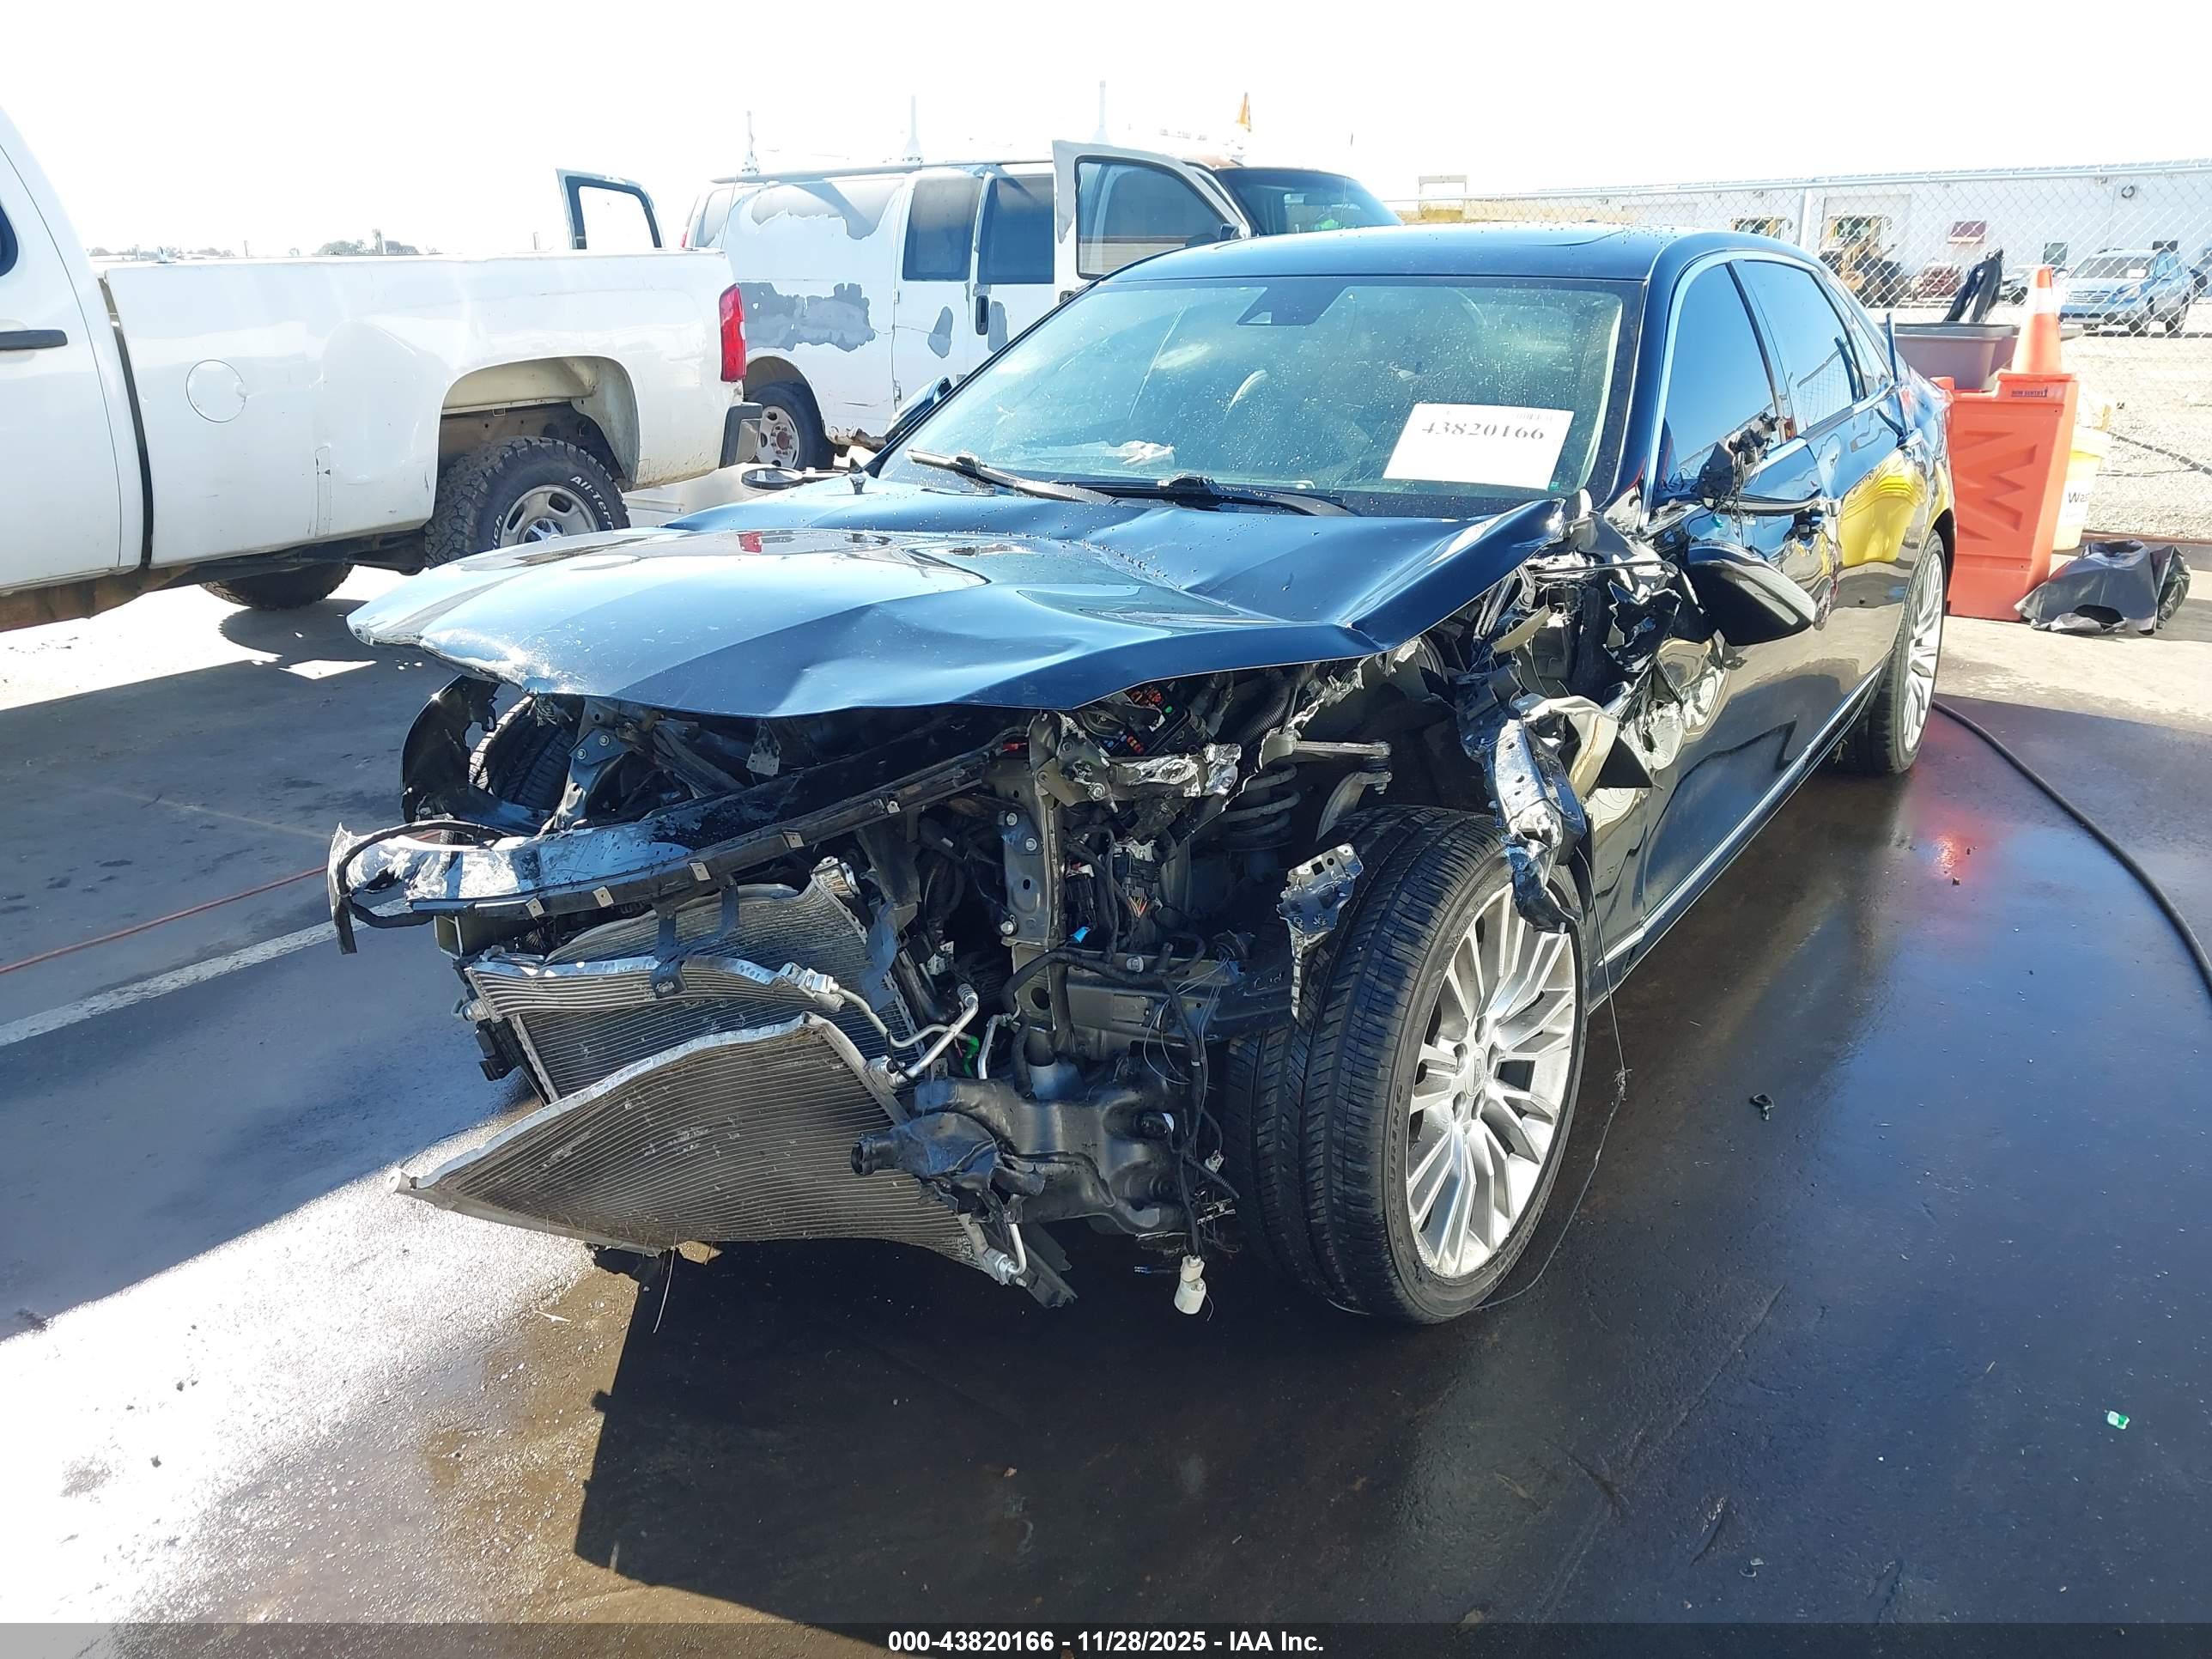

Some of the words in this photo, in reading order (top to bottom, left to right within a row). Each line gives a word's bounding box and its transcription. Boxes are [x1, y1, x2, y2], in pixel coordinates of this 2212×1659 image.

[1422, 422, 1544, 440] 43820166
[492, 514, 502, 550] ich
[1389, 1084, 1403, 1224] TOURING
